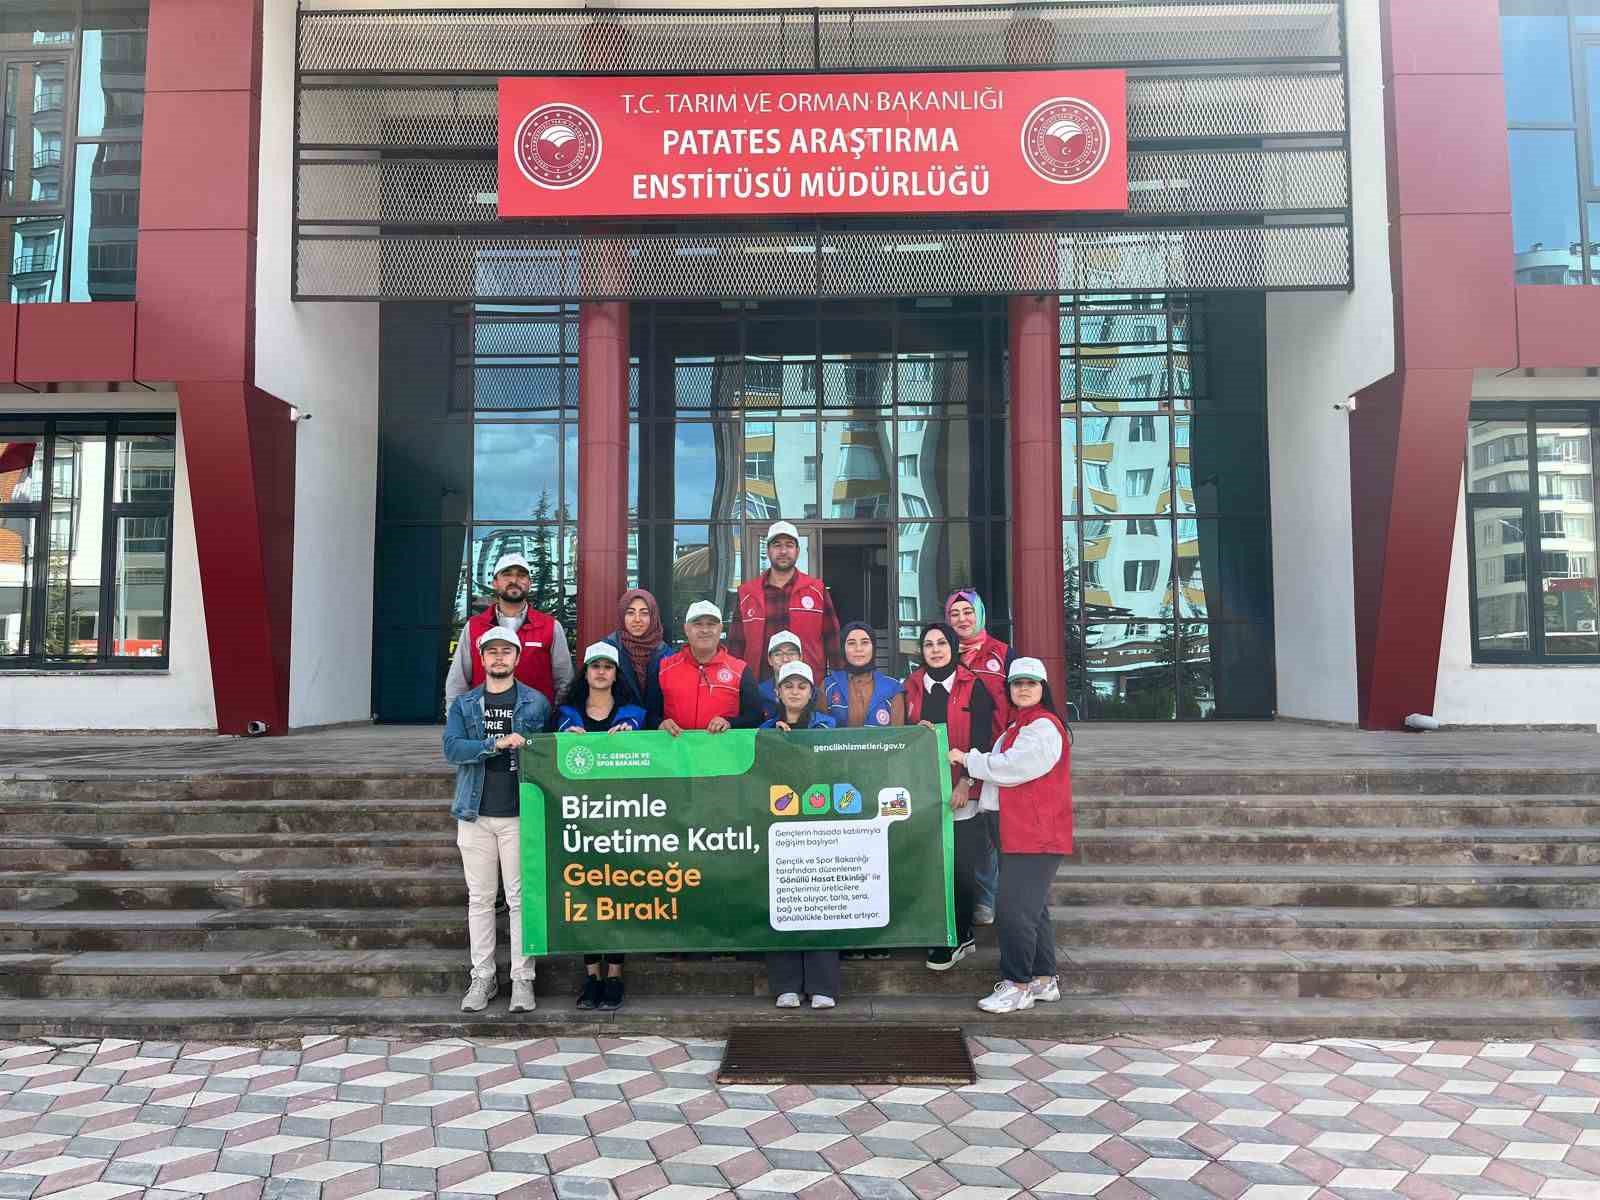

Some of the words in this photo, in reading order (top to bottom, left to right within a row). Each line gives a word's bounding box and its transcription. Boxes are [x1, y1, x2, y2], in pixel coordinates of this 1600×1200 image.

[620, 94, 660, 114] T.C.
[665, 93, 737, 113] TARIM
[743, 92, 772, 113] VE
[778, 92, 869, 112] ORMAN
[877, 86, 1003, 111] BAKANLIĞI
[663, 129, 781, 155] PATATES
[789, 127, 960, 160] ARAŞTIRMA
[632, 167, 792, 199] ENSTİTÜSÜ
[800, 165, 990, 197] MÜDÜRLÜĞÜ
[561, 793, 668, 819] Bizimle
[563, 824, 680, 853] Üretime
[688, 826, 760, 854] Katıl,
[815, 856, 833, 865] Spor
[563, 862, 702, 893] Geleceğe
[811, 875, 835, 883] Hasat
[564, 891, 588, 922] İz
[596, 897, 678, 921] Bırak!
[776, 895, 804, 903] destek
[776, 905, 792, 914] bağ
